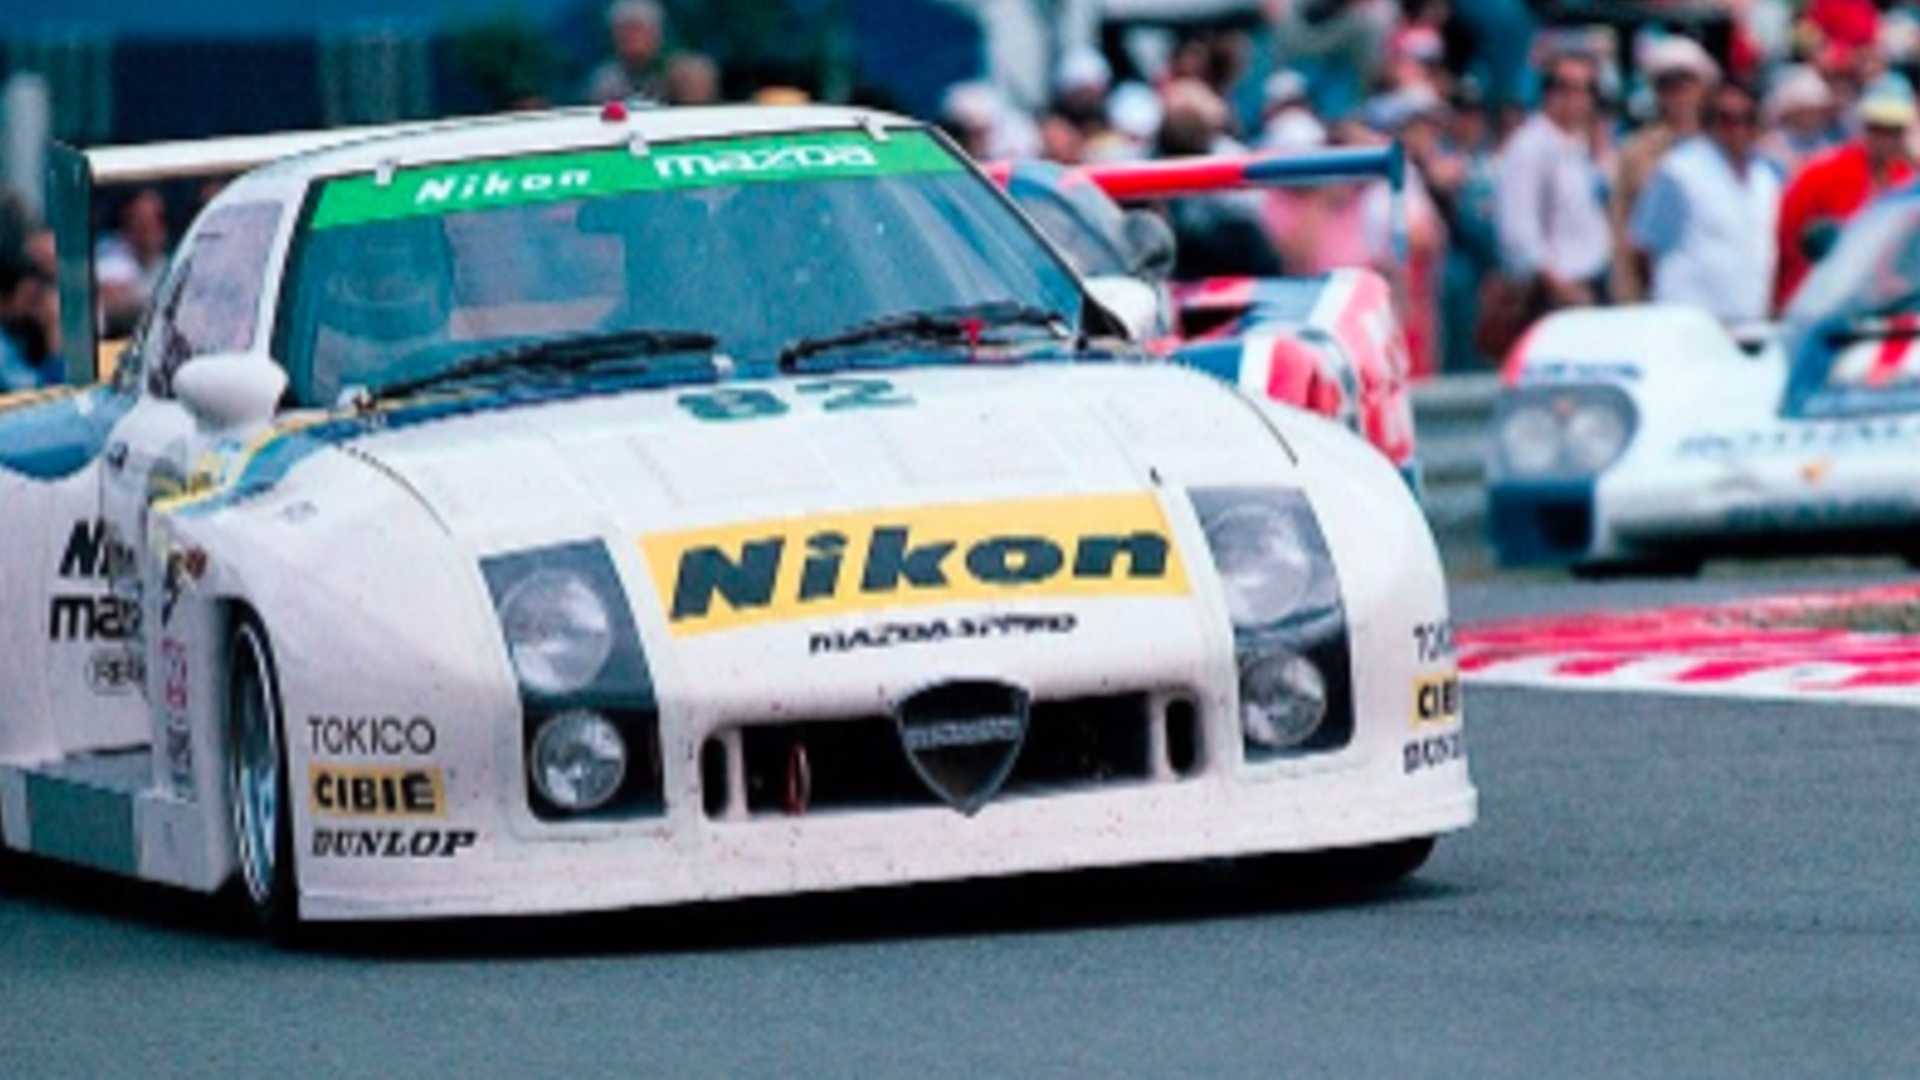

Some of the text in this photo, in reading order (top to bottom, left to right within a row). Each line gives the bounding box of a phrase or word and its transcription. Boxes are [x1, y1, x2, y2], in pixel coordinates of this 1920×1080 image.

[414, 143, 879, 204] Nikon mazda
[668, 524, 1170, 621] Nikon
[307, 715, 437, 755] TOKICO
[311, 828, 478, 858] DUNLOP
